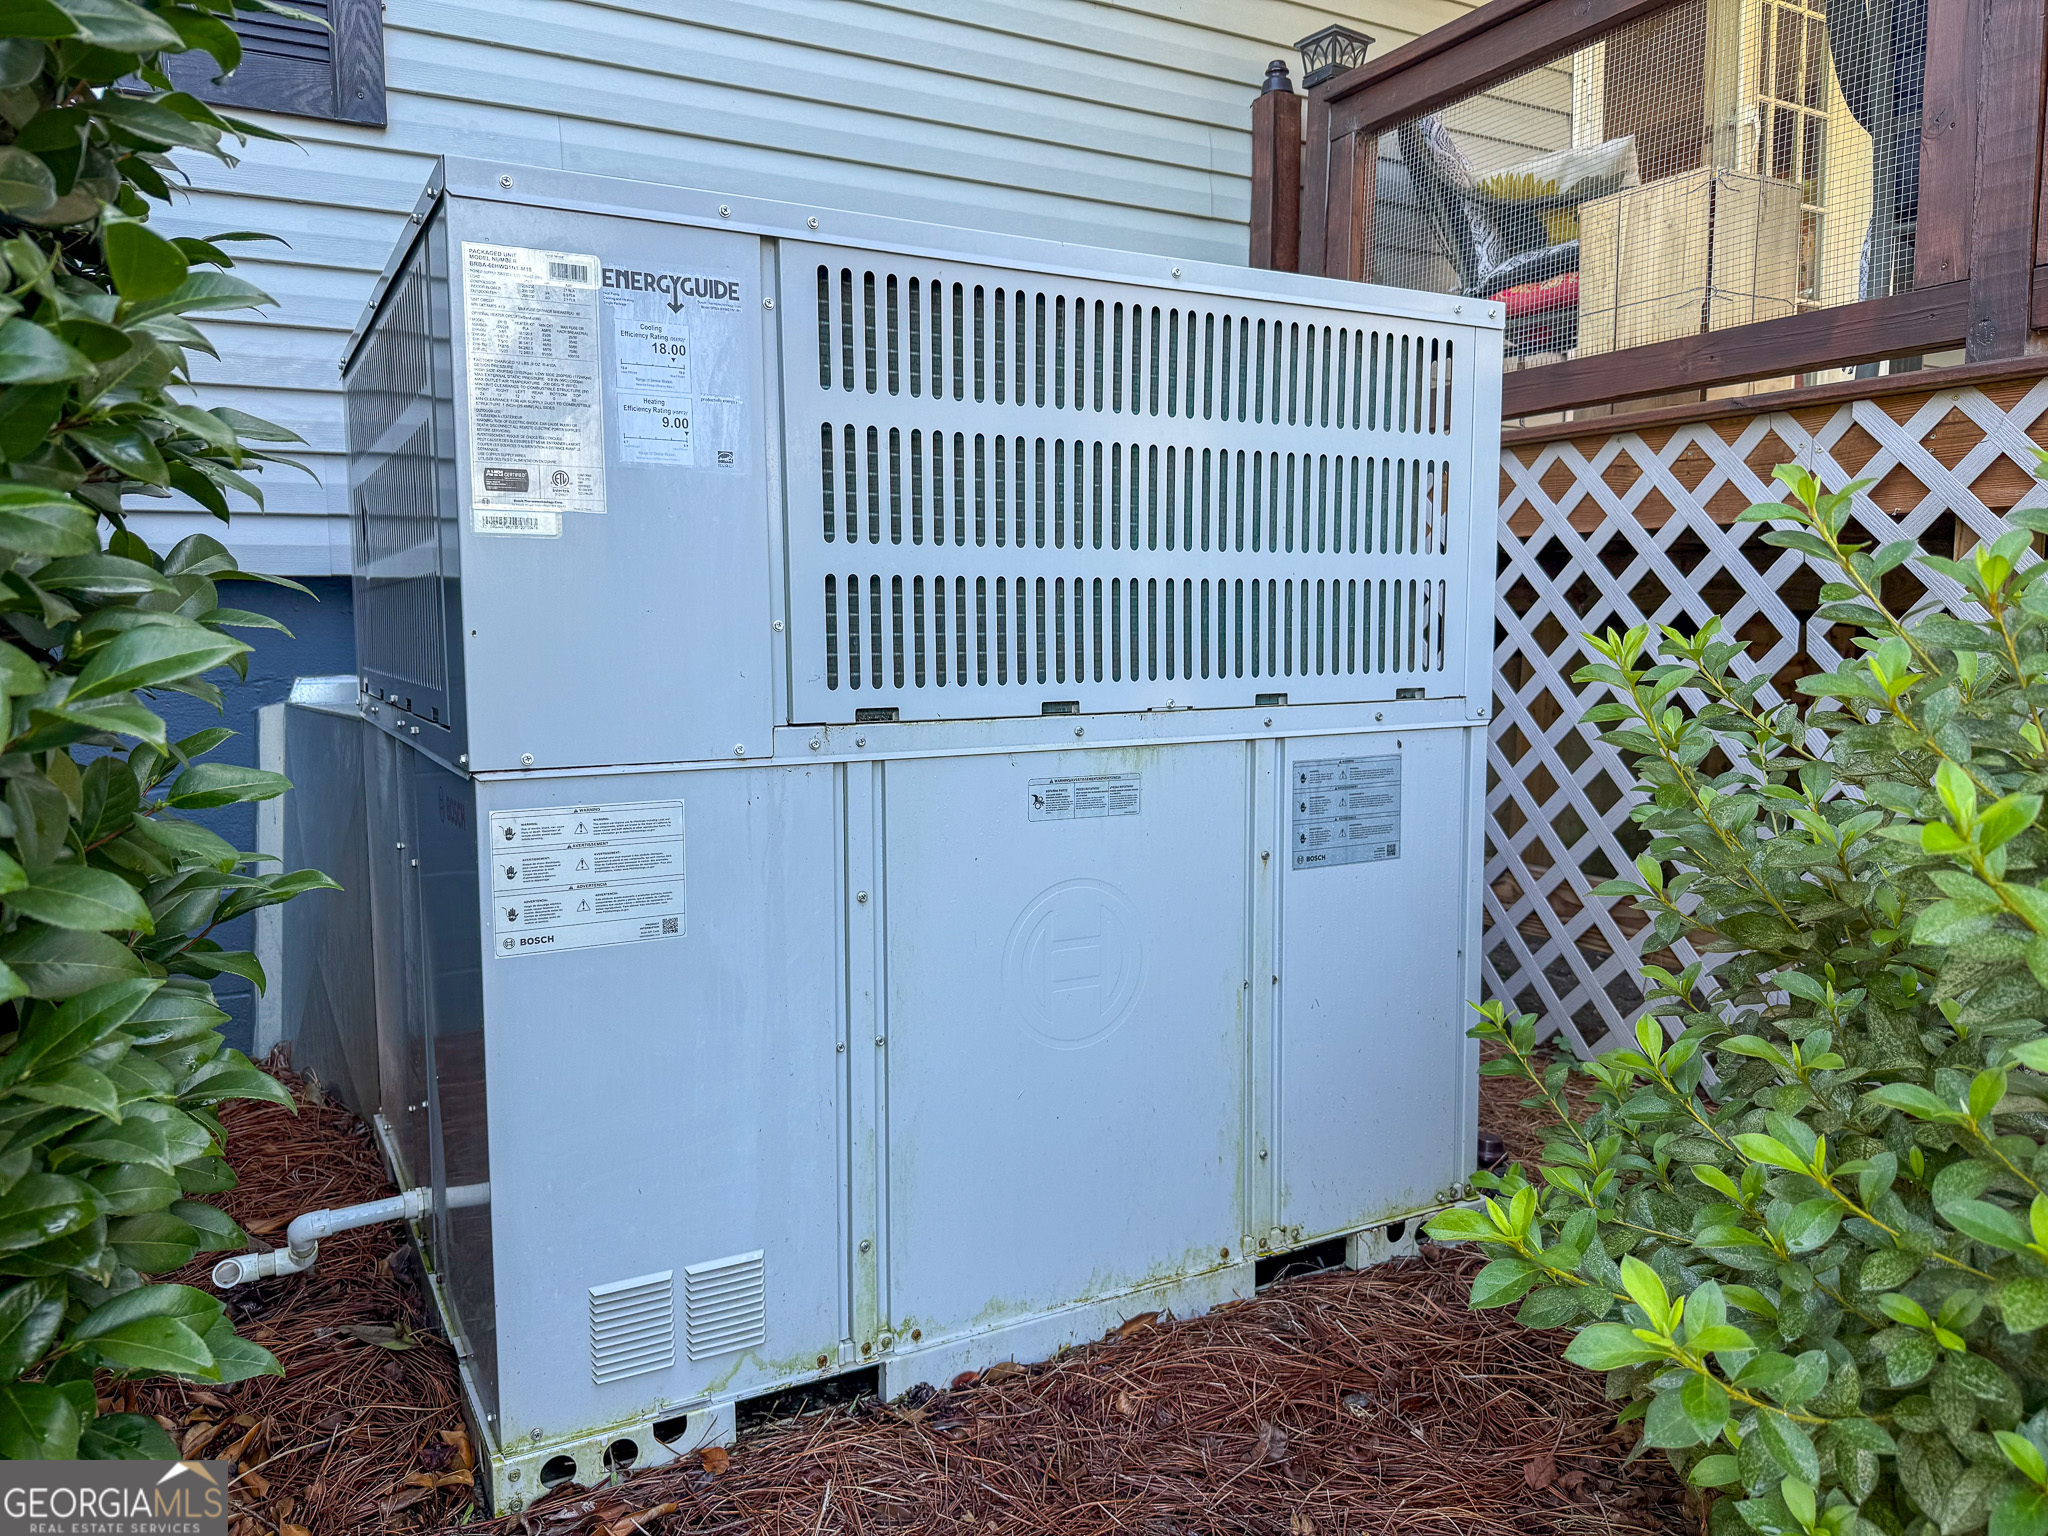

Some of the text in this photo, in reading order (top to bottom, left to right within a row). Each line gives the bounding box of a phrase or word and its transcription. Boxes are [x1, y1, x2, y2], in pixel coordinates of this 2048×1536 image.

[469, 248, 502, 256] PACKAGED
[602, 268, 740, 303] ENERGYGUIDE
[640, 324, 662, 332] Cooling
[620, 330, 648, 340] Efficiency
[650, 333, 668, 342] Rating
[652, 342, 686, 356] 18.00
[644, 398, 665, 406] Heating
[624, 405, 651, 414] Efficiency
[653, 407, 671, 415] Rating
[662, 416, 689, 429] 9.00
[446, 796, 466, 830] BOSCH
[520, 935, 555, 946] BOSCH
